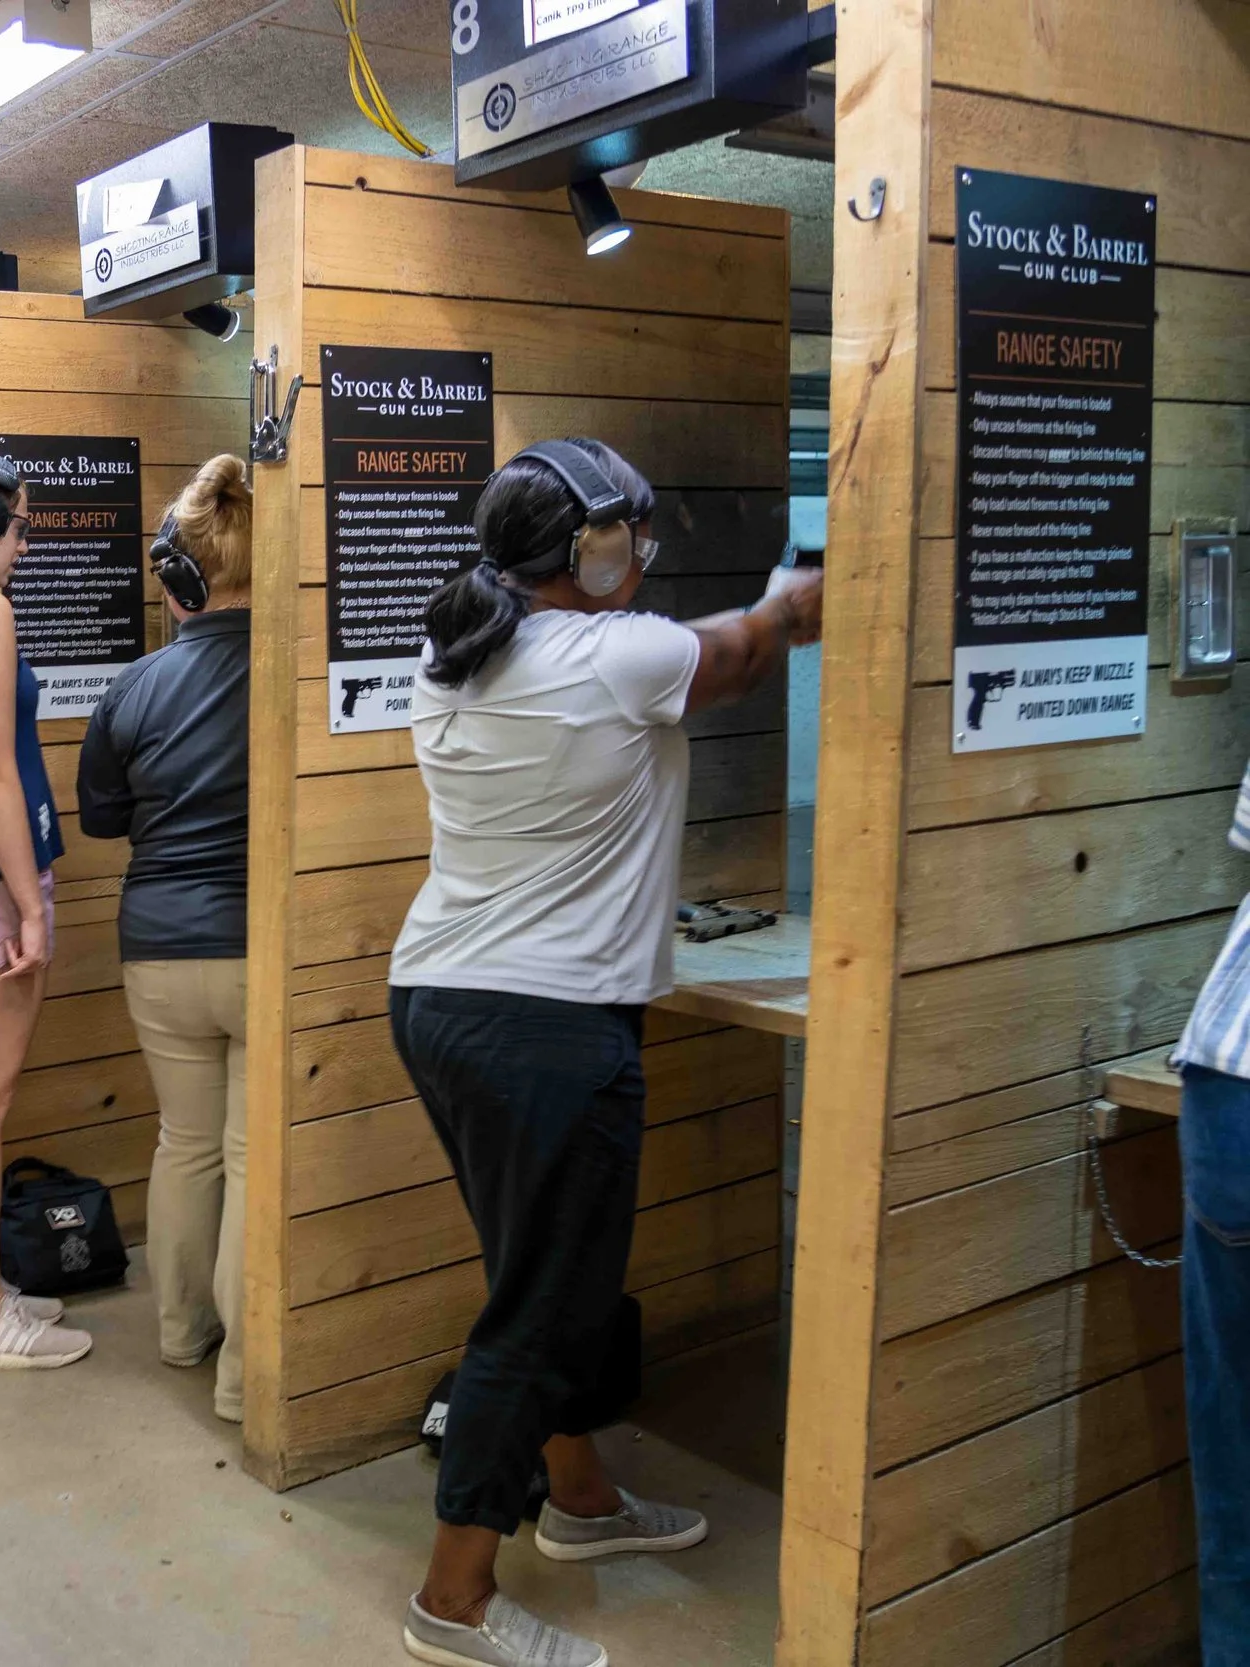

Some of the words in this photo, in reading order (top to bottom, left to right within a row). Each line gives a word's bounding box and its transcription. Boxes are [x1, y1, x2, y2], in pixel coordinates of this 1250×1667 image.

[537, 10, 561, 25] Canik
[567, 3, 584, 16] TP9
[453, 0, 480, 54] 8
[608, 21, 669, 55] RANGE
[632, 52, 656, 70] LLC
[115, 231, 157, 256] SHOOTING
[967, 211, 1041, 254] STOCK
[1046, 224, 1067, 257] &
[1073, 224, 1149, 266] BARREL
[121, 244, 170, 268] INDUSTRIES
[1024, 264, 1054, 280] GUN
[1061, 266, 1098, 285] CLUB
[997, 331, 1055, 366] RANGE
[1060, 336, 1123, 370] SAFETY
[330, 372, 393, 398] STOCK
[398, 378, 415, 399] &
[420, 376, 487, 401] BARREL
[973, 391, 998, 408] Always
[999, 395, 1026, 408] assume
[1027, 393, 1041, 408] that
[1042, 396, 1056, 412] your
[1058, 395, 1081, 410] firearm
[1082, 396, 1088, 410] is
[1089, 397, 1112, 412] loaded
[379, 404, 406, 415] GUN
[411, 405, 443, 416] CLUB
[973, 418, 989, 435] Only
[990, 421, 1015, 433] uncase
[1016, 419, 1044, 434] firearms
[1045, 422, 1052, 435] at
[1053, 421, 1064, 435] the
[1065, 421, 1082, 438] firing
[1083, 422, 1096, 436] line
[58, 457, 74, 473] &
[78, 456, 134, 474] BARREL
[357, 450, 408, 472] RANGE
[412, 451, 467, 473] SAFETY
[70, 478, 97, 486] CLUB
[338, 491, 359, 504] Always
[361, 493, 383, 501] assume
[385, 492, 396, 501] that
[397, 493, 410, 503] your
[411, 491, 432, 501] firearm
[433, 491, 438, 501] is
[439, 491, 458, 501] loaded
[28, 512, 69, 528] RANGE
[71, 512, 118, 528] SAFETY
[339, 509, 352, 521] Only
[353, 511, 375, 519] uncase
[376, 509, 400, 519] firearms
[401, 510, 407, 518] at
[408, 508, 417, 518] the
[418, 508, 433, 520] firing
[434, 508, 445, 518] line
[339, 527, 365, 537] Uncased
[366, 526, 390, 536] firearms
[391, 528, 404, 538] may
[403, 527, 424, 537] never
[425, 525, 432, 536] be
[433, 525, 453, 535] behind
[453, 525, 462, 535] the
[339, 544, 355, 556] Keep
[356, 546, 369, 556] your
[370, 544, 388, 556] finger
[388, 543, 396, 553] off
[397, 543, 407, 553] the
[408, 543, 427, 554] trigger
[428, 542, 441, 552] until
[442, 542, 458, 554] ready
[459, 542, 464, 551] to
[465, 542, 481, 551] shoot
[340, 562, 354, 574] Only
[390, 561, 415, 570] firearms
[415, 561, 421, 570] at
[422, 560, 432, 569] the
[433, 559, 448, 571] firing
[449, 559, 460, 569] line
[340, 580, 358, 589] Never
[359, 581, 375, 589] move
[376, 578, 399, 588] forward
[400, 577, 406, 587] of
[407, 577, 416, 587] the
[417, 577, 432, 589] firing
[433, 576, 444, 586] line
[340, 597, 346, 607] If
[346, 598, 357, 608] you
[358, 596, 372, 606] have
[379, 595, 413, 605] malfunction
[414, 594, 428, 604] keep
[339, 610, 357, 619] down
[358, 609, 375, 620] range
[377, 608, 388, 617] and
[389, 607, 406, 618] safely
[406, 606, 425, 618] signal
[341, 626, 353, 637] You
[353, 628, 366, 637] may
[367, 625, 380, 636] only
[381, 624, 396, 635] draw
[396, 624, 410, 634] from
[411, 623, 420, 632] the
[394, 636, 418, 647] through
[386, 675, 415, 689] ALWA
[1019, 668, 1062, 688] ALWAYS
[1065, 665, 1090, 685] KEEP
[1093, 661, 1135, 682] MUZZLE
[51, 678, 82, 689] ALWAYS
[84, 677, 104, 687] KEEP
[50, 695, 85, 705] POINTED
[385, 698, 412, 711] POINT
[1017, 700, 1064, 721] POINTED
[1067, 697, 1098, 715] DOWN
[1099, 693, 1135, 712] RANGE
